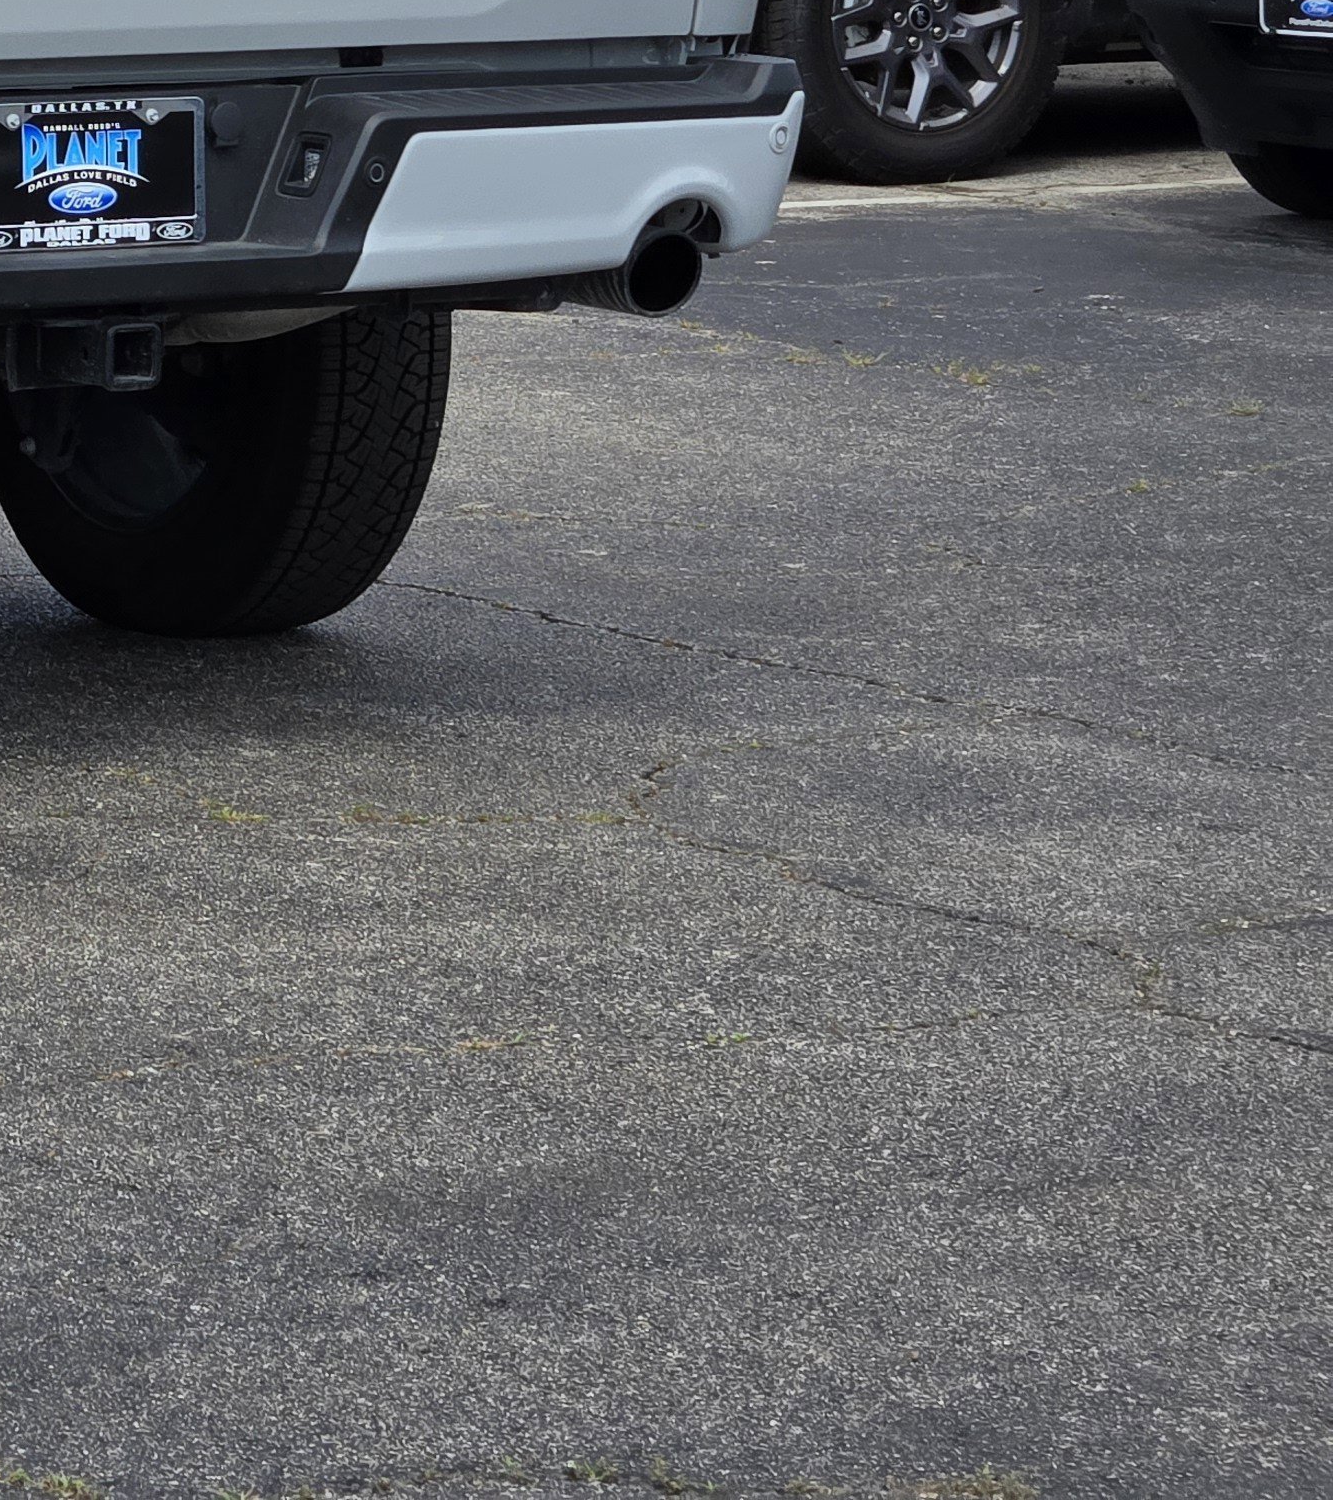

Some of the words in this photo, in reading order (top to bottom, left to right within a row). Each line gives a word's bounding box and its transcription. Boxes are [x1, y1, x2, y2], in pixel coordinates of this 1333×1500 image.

[21, 123, 142, 183] PLANET
[27, 173, 70, 193] DALLAS
[74, 171, 102, 180] LOVE
[106, 173, 138, 187] FIELD
[62, 188, 103, 209] Ford
[20, 225, 93, 247] PLANET
[98, 222, 150, 241] FORD
